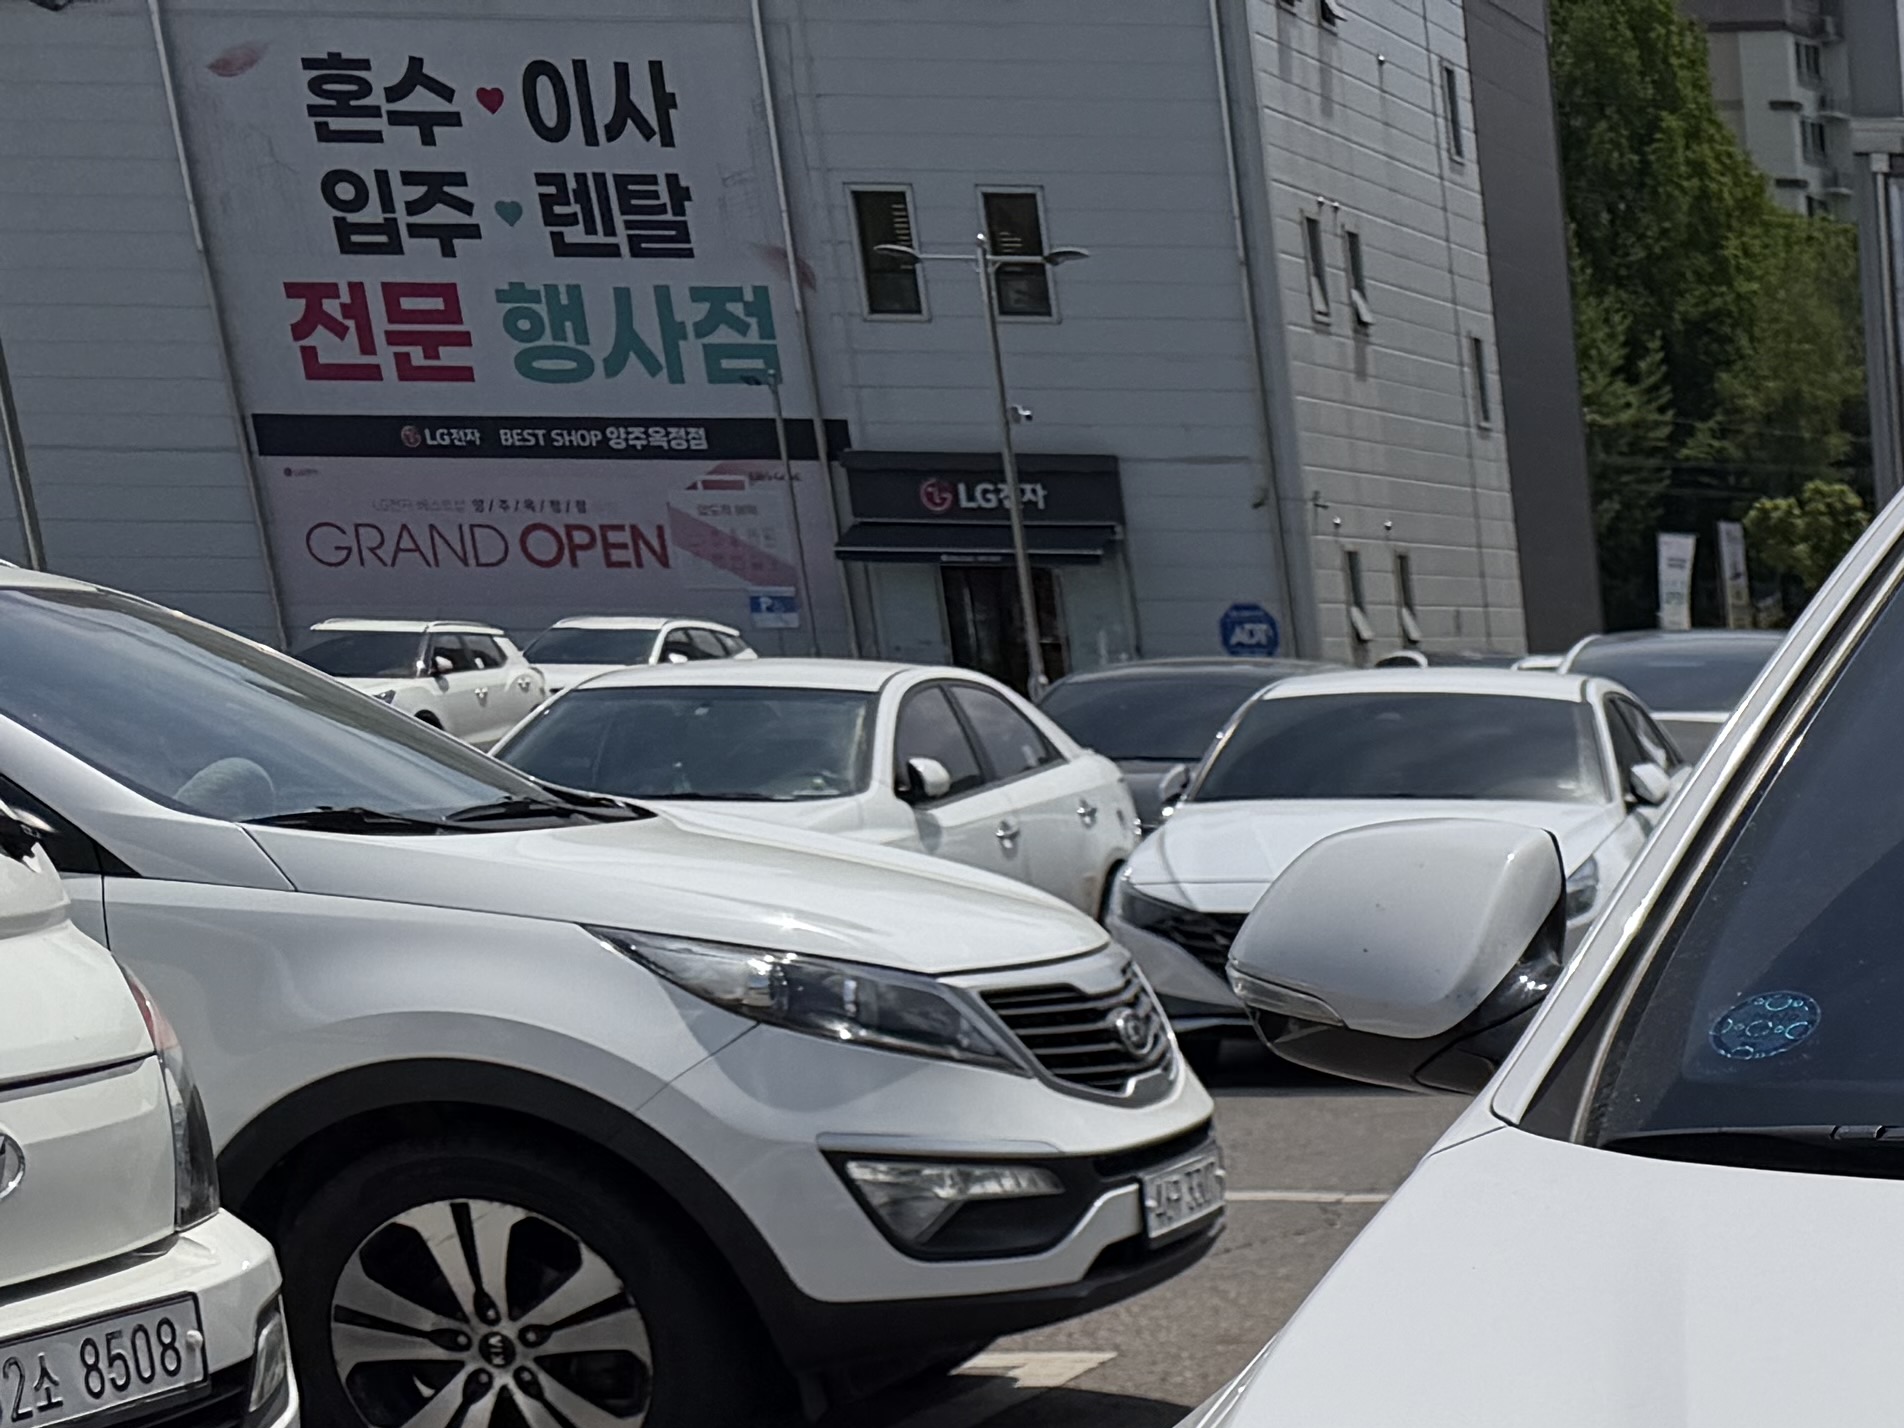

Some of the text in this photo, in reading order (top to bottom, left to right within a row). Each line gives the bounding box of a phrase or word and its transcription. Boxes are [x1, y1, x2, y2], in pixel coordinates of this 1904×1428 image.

[301, 52, 678, 147] 혼수 이사
[320, 168, 695, 259] 입주 렌탈
[283, 281, 784, 384] 전문 행사점
[424, 426, 708, 450] LG전자 BEST SHOP 양주옥정점
[306, 521, 509, 568] GRAND
[519, 522, 672, 569] OPEN
[0, 1316, 182, 1423] 2소 8508
